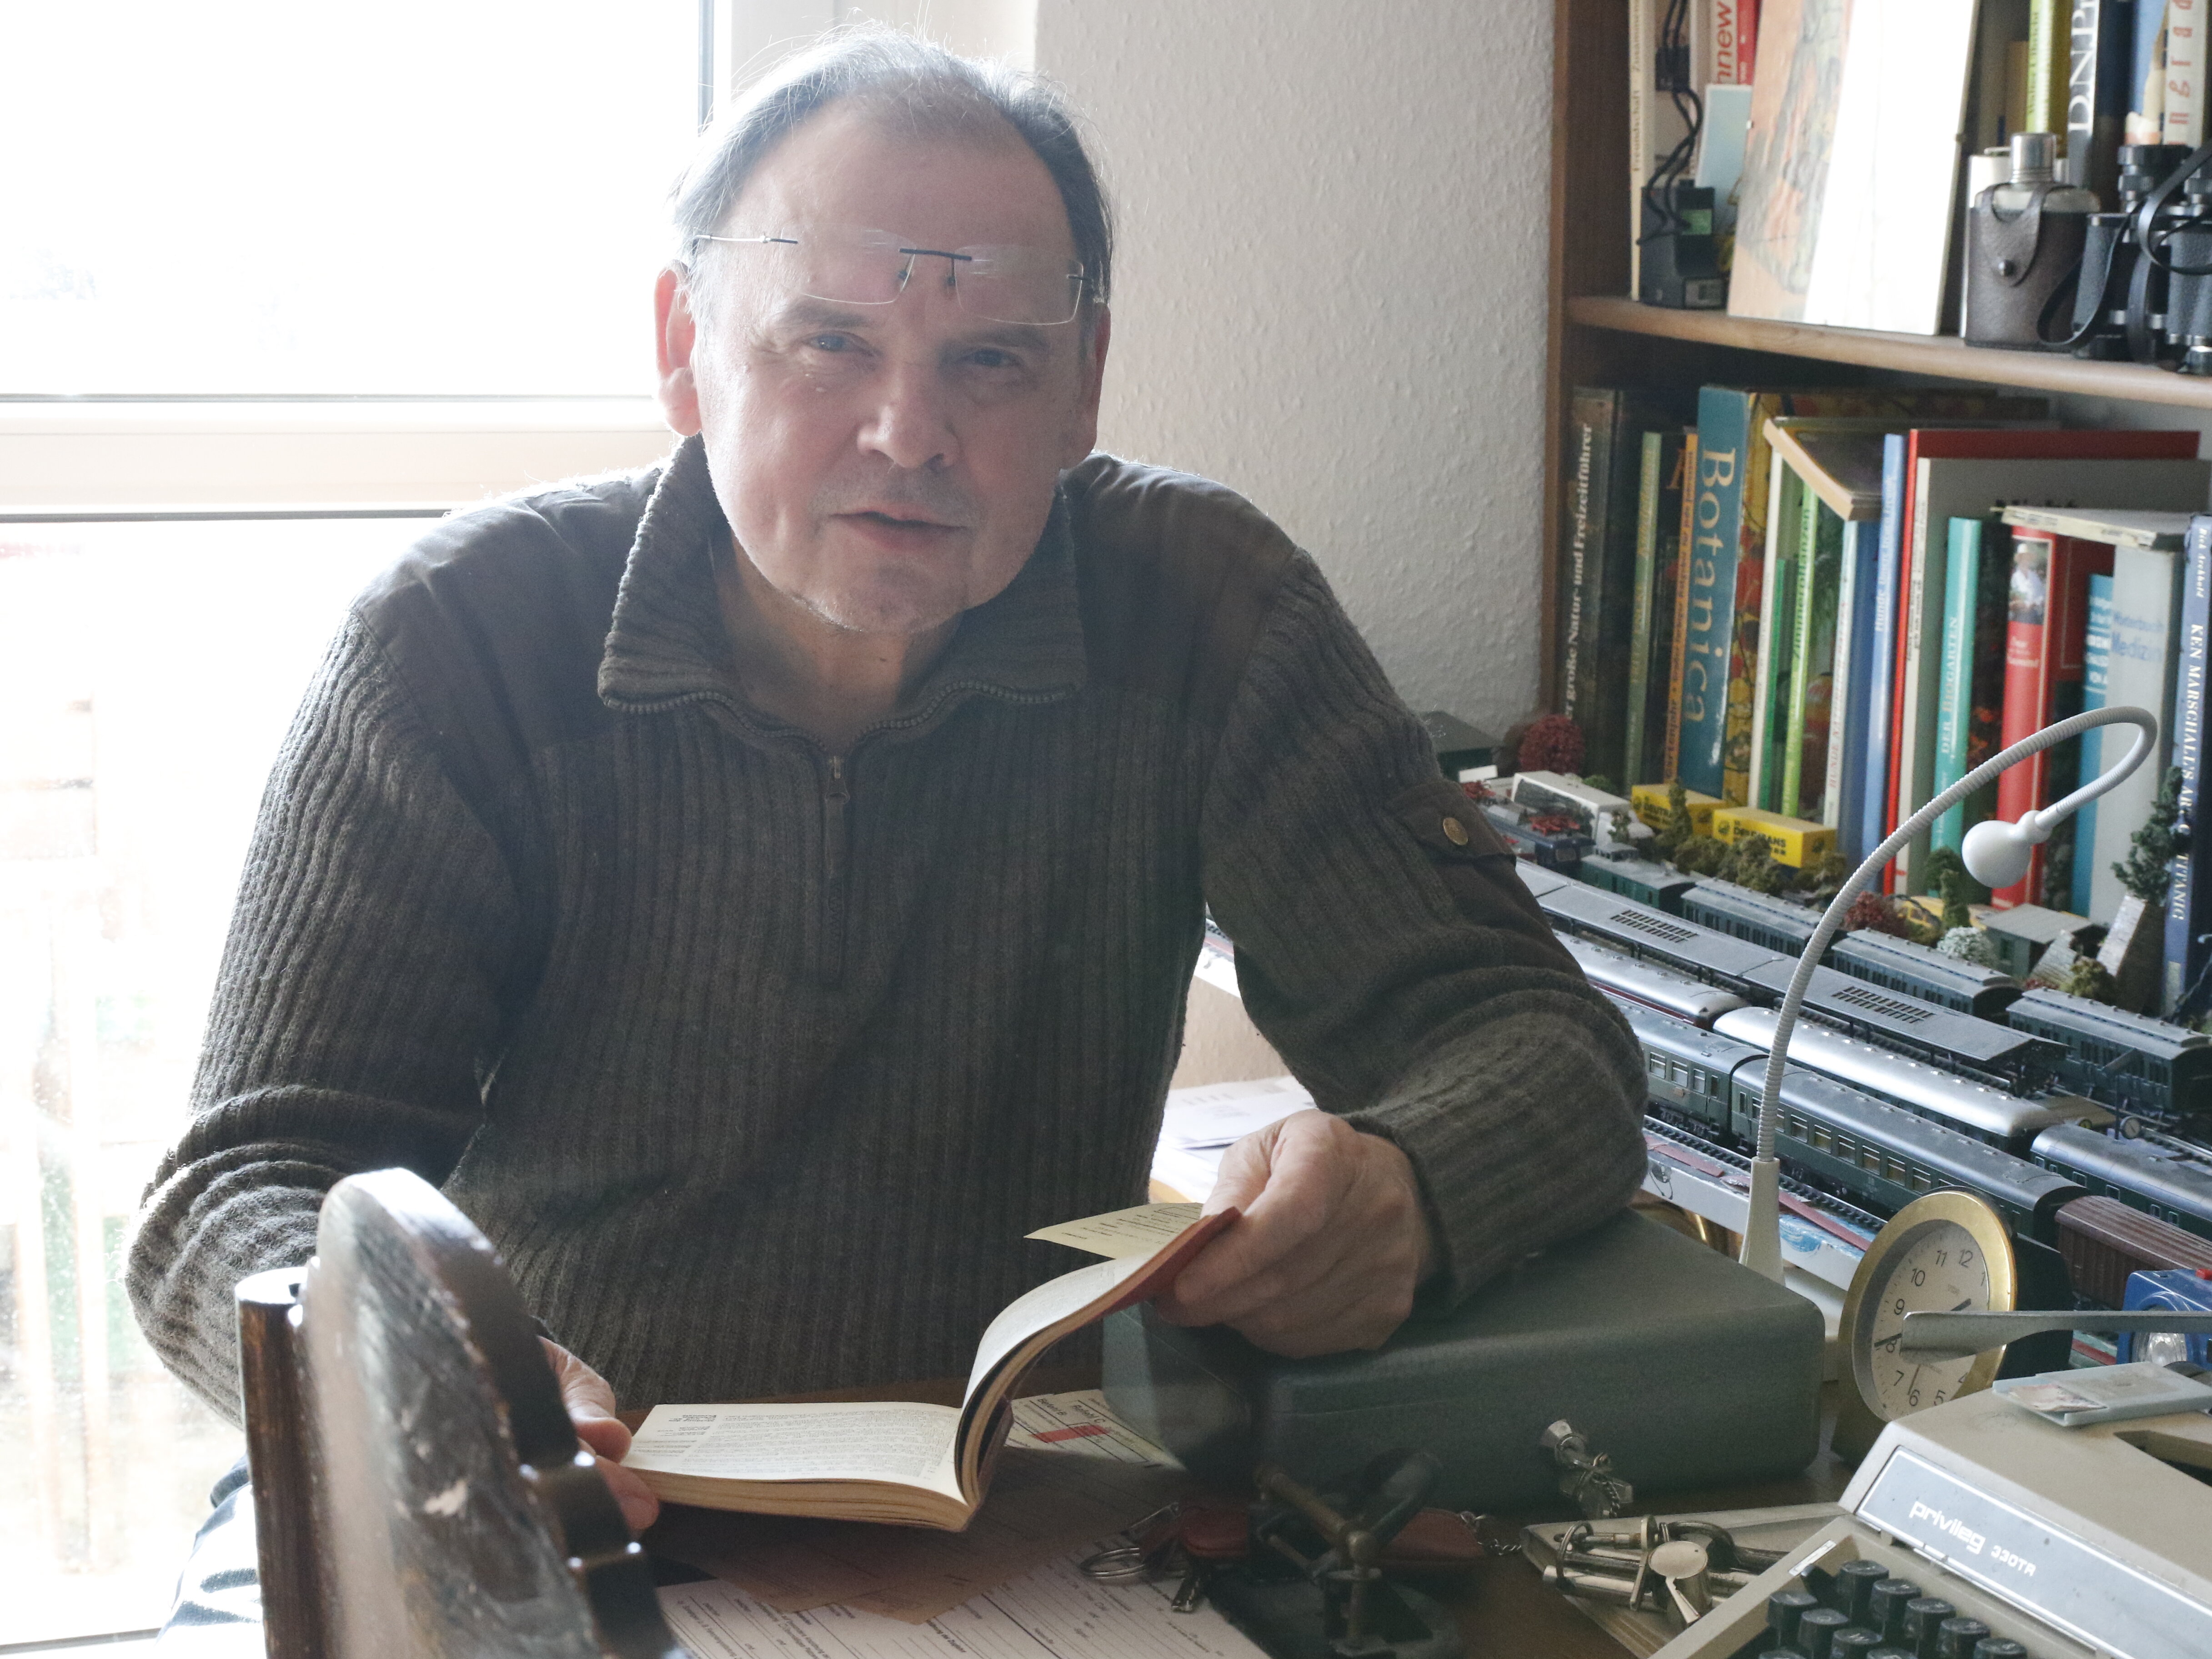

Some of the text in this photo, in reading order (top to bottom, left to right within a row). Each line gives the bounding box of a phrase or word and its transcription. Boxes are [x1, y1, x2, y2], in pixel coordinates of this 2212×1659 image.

[1573, 423, 1592, 548] Freizeitführer
[1574, 551, 1585, 585] und
[1683, 447, 1735, 722] Botanica
[1792, 508, 1811, 660] Zimmerpflanzen
[1569, 588, 1581, 644] Natur-
[1875, 590, 1886, 632] Hunde
[2189, 624, 2203, 659] KEN
[1566, 648, 1578, 699] große
[1941, 722, 1951, 755] DER
[2182, 664, 2202, 780] MARSCHALL'S
[2172, 853, 2189, 920] TITANIC
[1911, 1268, 1926, 1287] 10
[1936, 1249, 1973, 1268] 11 12
[1894, 1299, 1905, 1315] 9
[1886, 1337, 1897, 1353] 8
[1894, 1370, 1904, 1387] 7
[1909, 1389, 1946, 1407] 6 5
[1909, 1500, 2037, 1578] privileg 330TR
